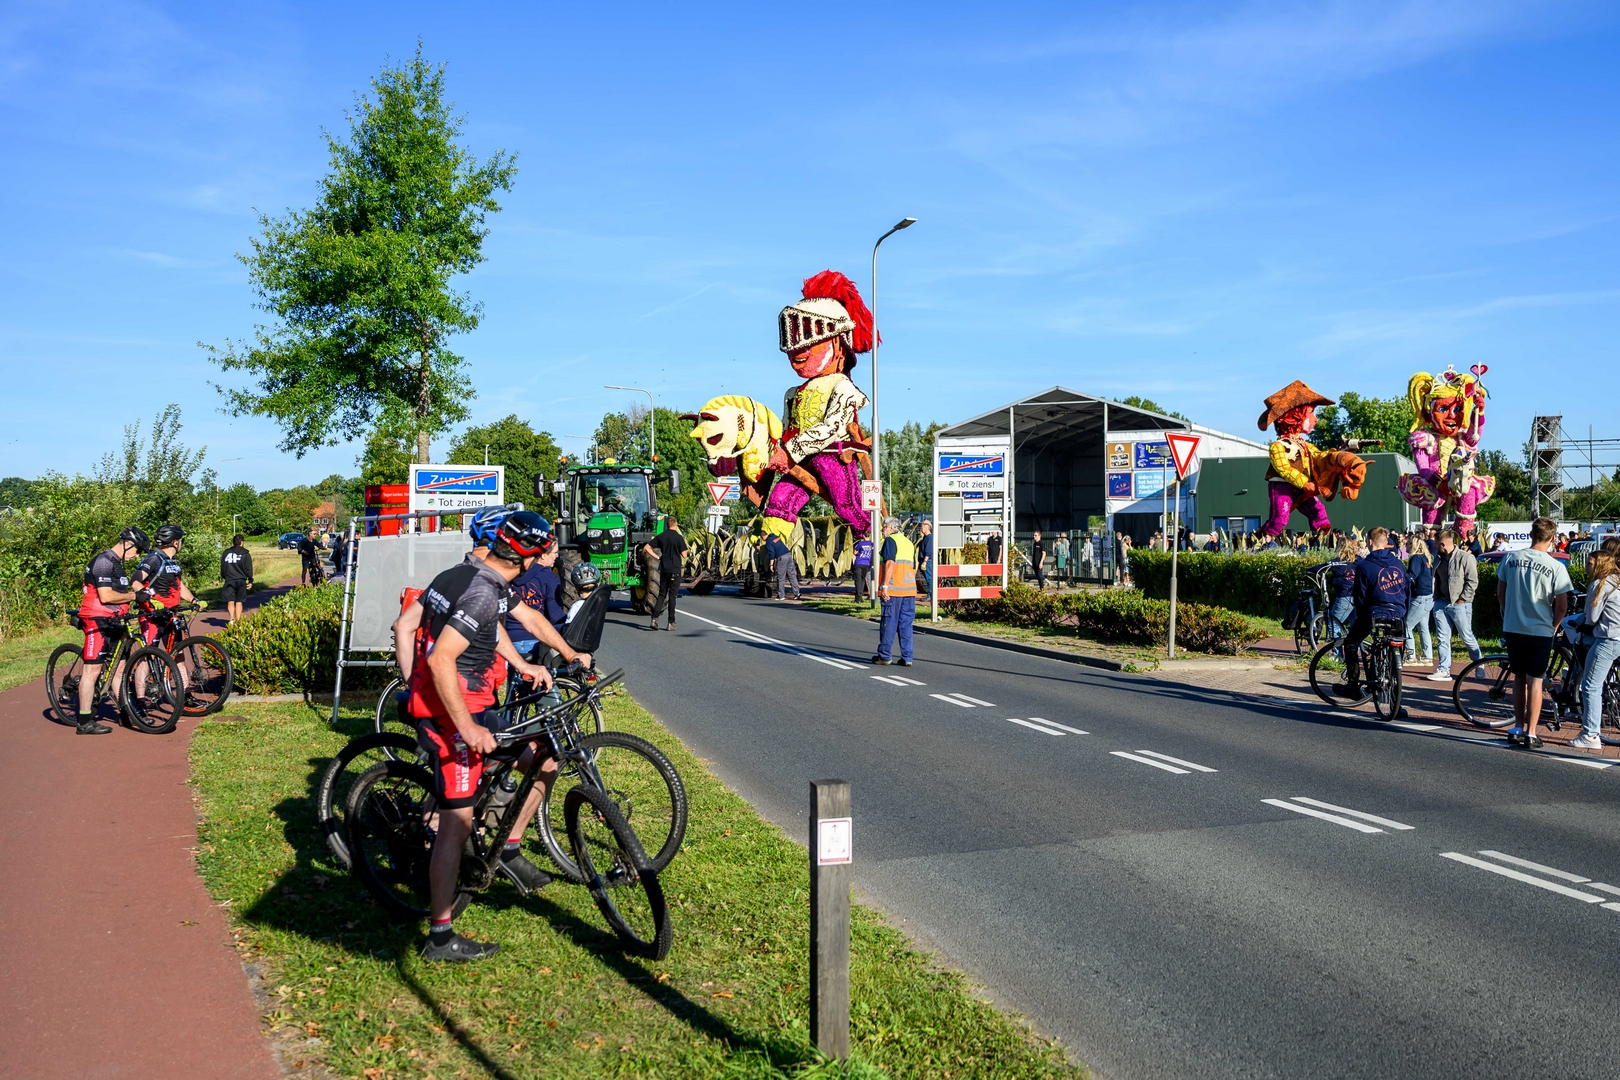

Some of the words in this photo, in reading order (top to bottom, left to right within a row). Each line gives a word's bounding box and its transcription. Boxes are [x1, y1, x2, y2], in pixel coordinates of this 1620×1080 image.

[949, 458, 994, 469] Zundert
[430, 474, 484, 486] Zundert
[438, 498, 454, 507] Tot
[457, 498, 486, 507] ziens!
[1508, 559, 1553, 578] MALELIONS
[454, 732, 469, 792] MRTENS
